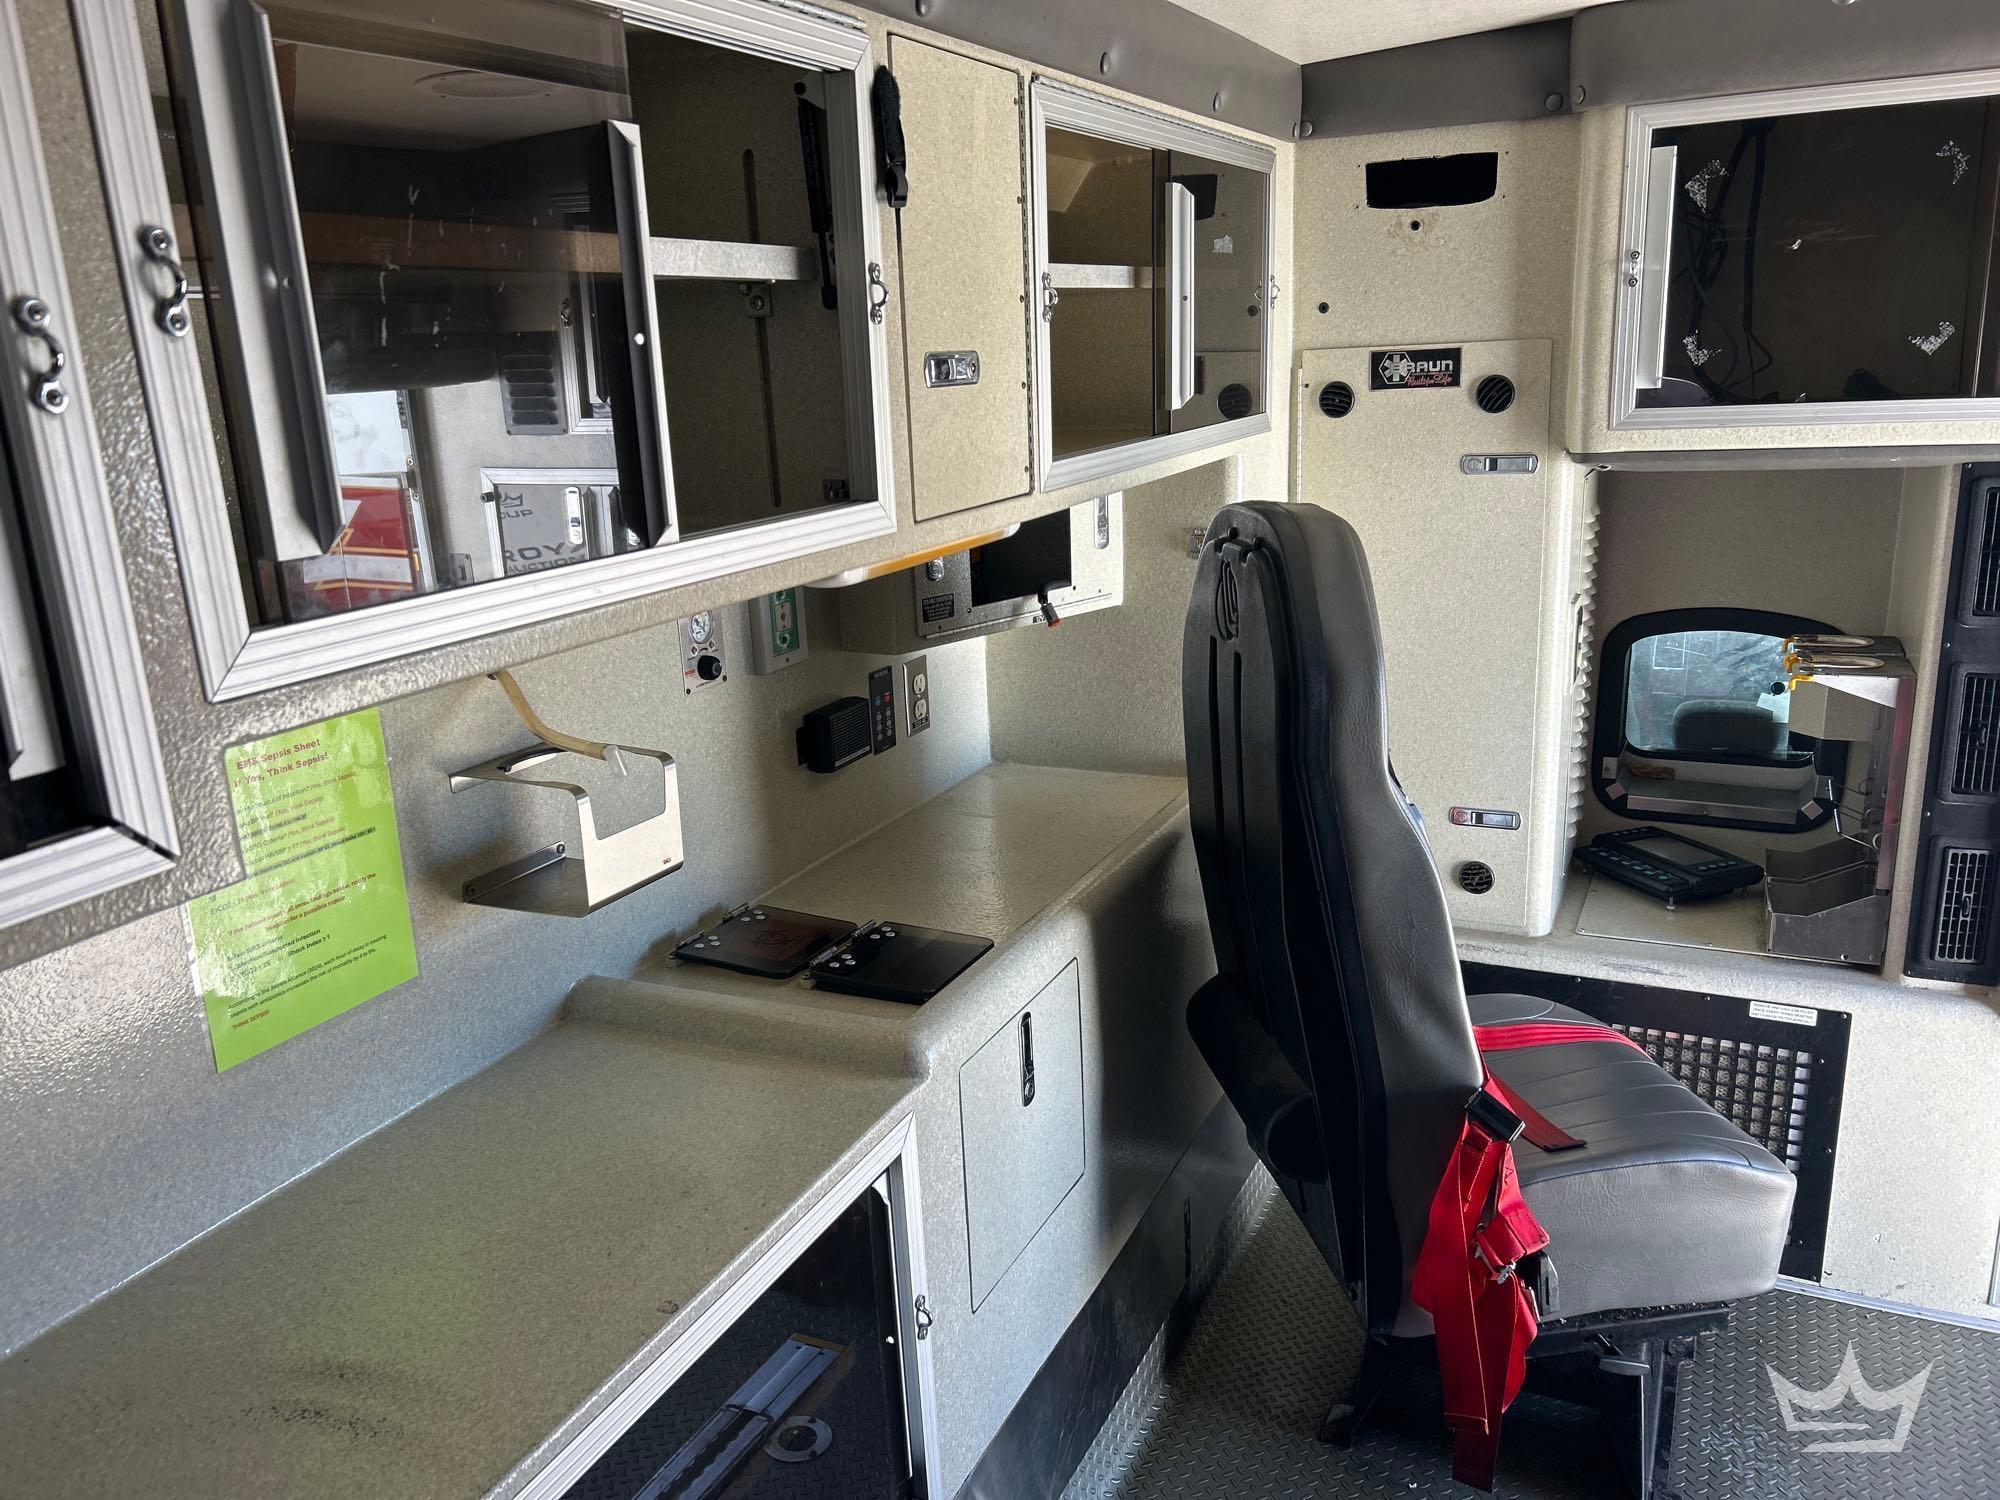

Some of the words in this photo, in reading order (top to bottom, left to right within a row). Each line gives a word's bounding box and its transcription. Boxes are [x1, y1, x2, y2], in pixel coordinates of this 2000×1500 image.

[260, 746, 292, 763] Sepsis
[293, 738, 320, 752] Sheet
[266, 763, 293, 777] Think
[295, 752, 328, 769] Sepsis!
[295, 928, 320, 942] Infection
[369, 934, 386, 945] treating
[287, 944, 306, 956] Shock
[306, 938, 321, 948] Index
